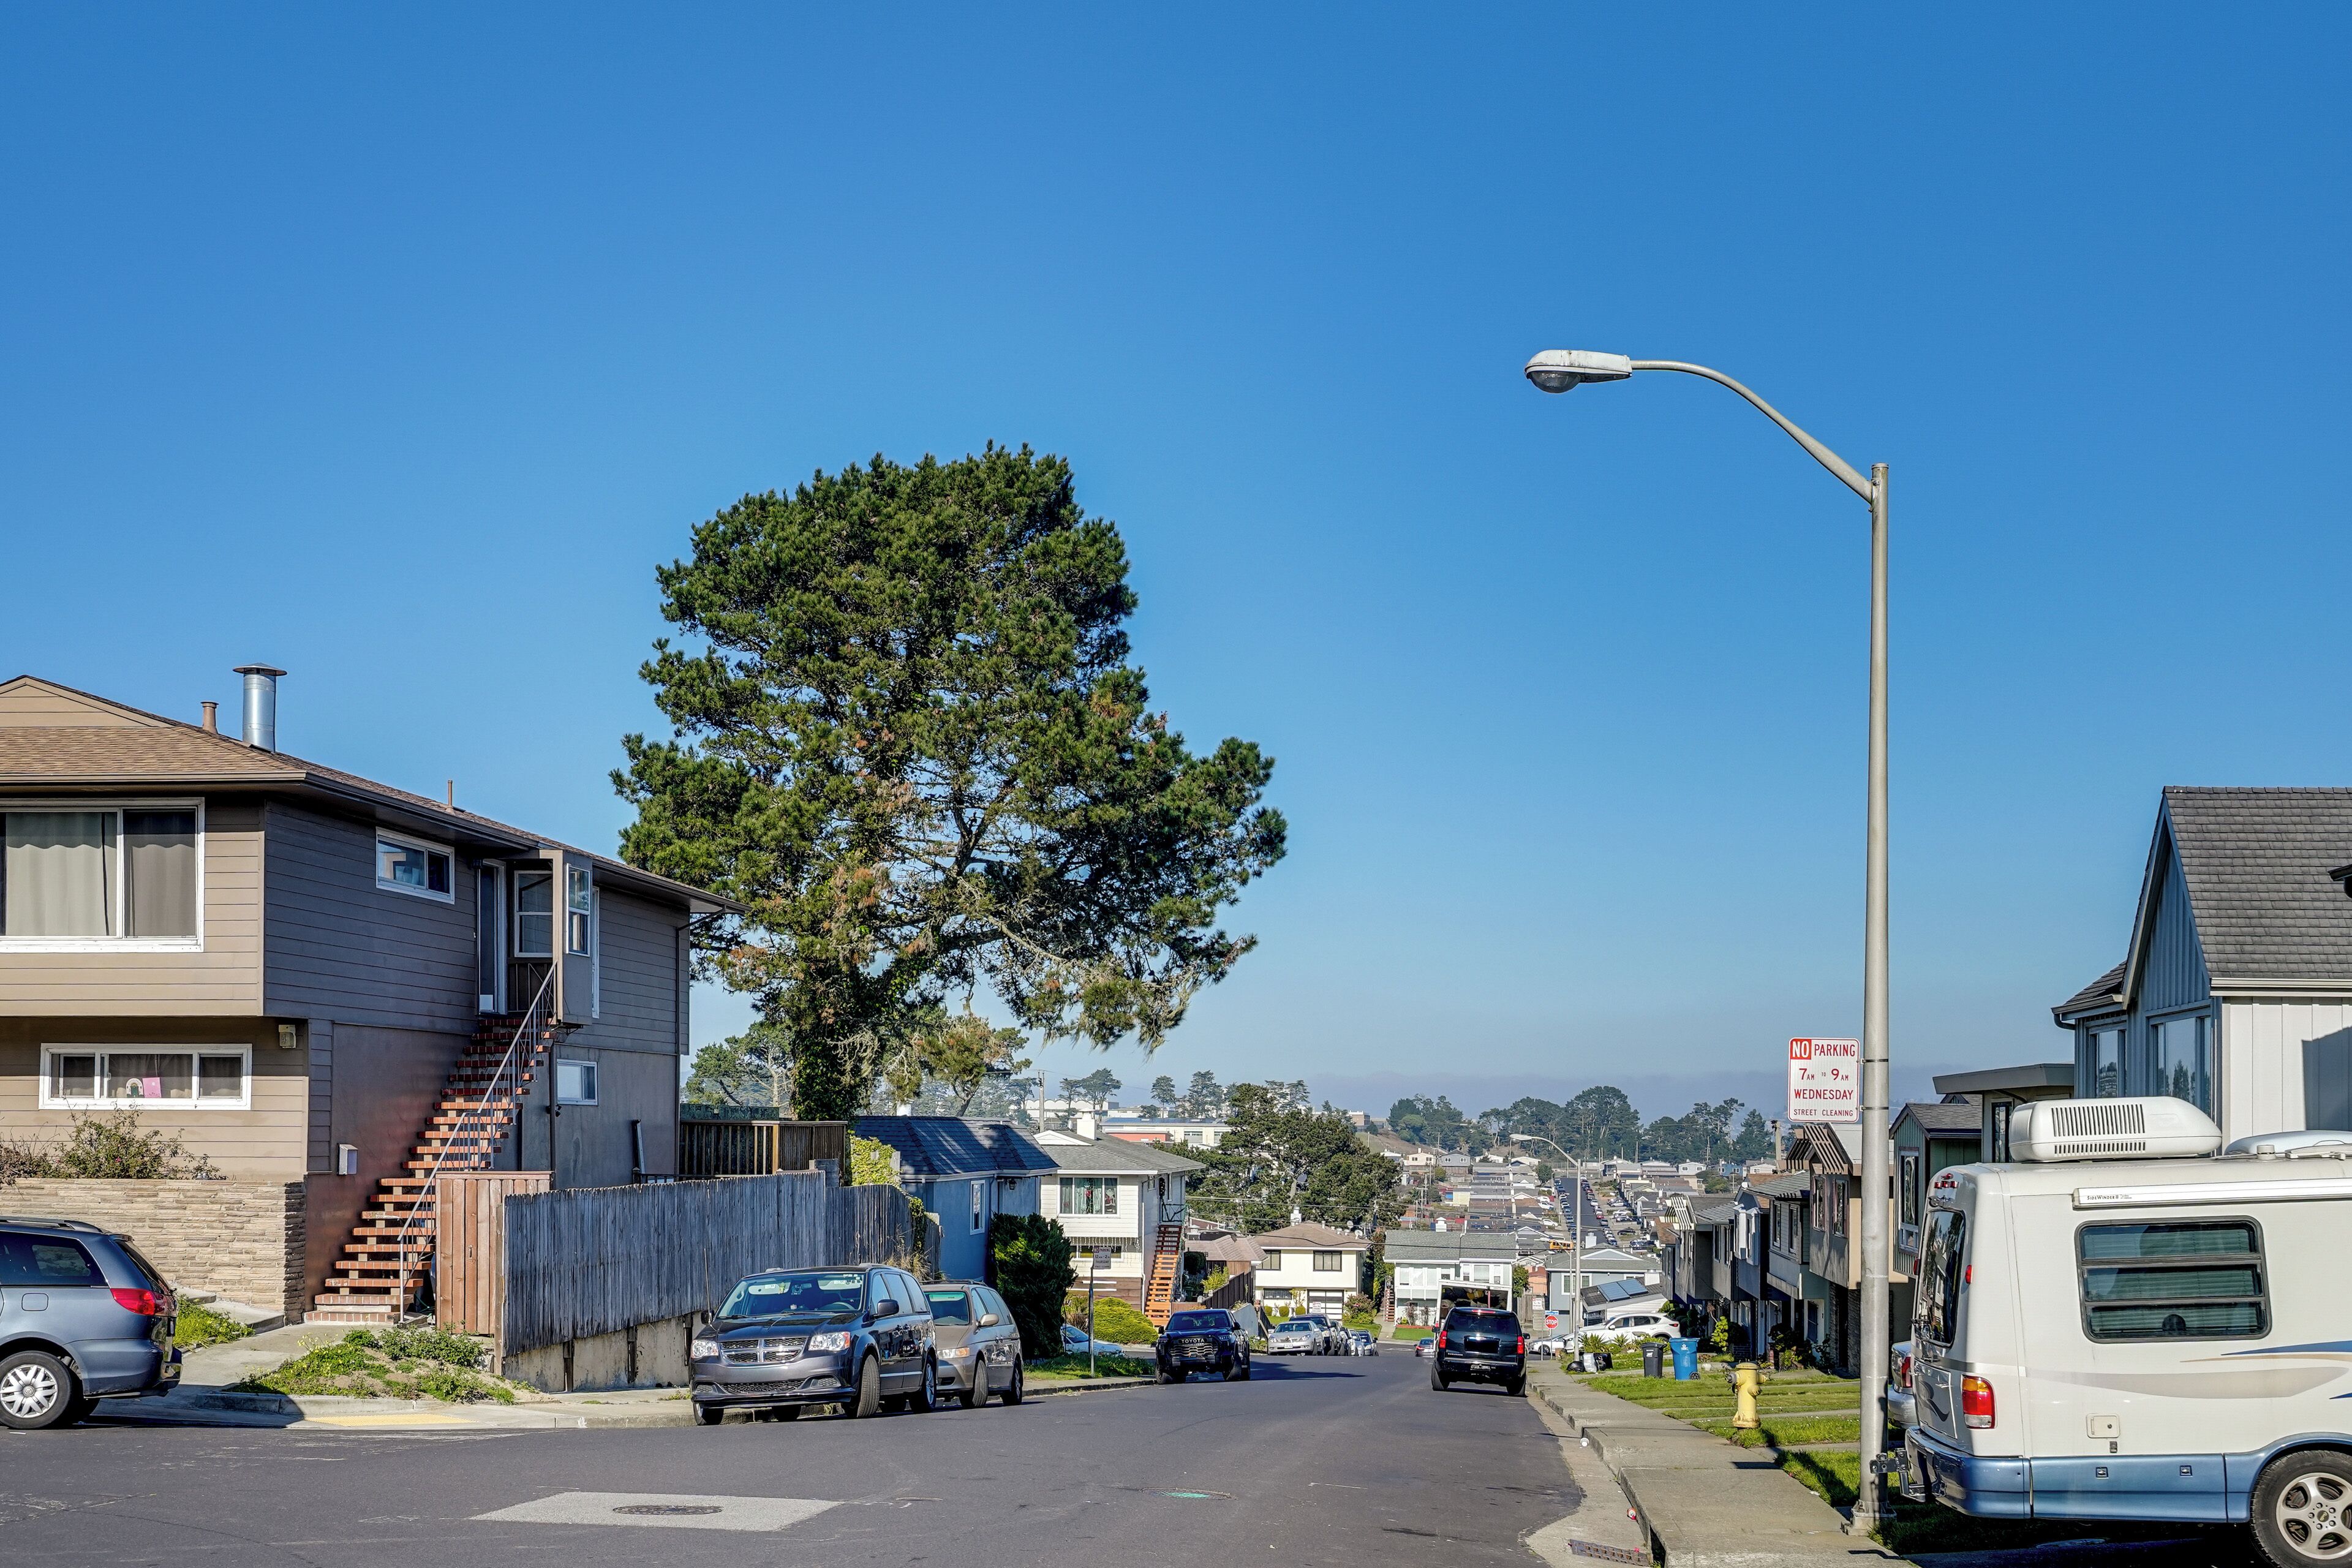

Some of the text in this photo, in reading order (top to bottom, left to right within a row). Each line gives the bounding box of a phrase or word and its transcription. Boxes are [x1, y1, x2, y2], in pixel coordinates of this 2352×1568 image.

[1792, 1041, 1856, 1058] NO PARKING
[1794, 1088, 1853, 1100] WEDNESDAY
